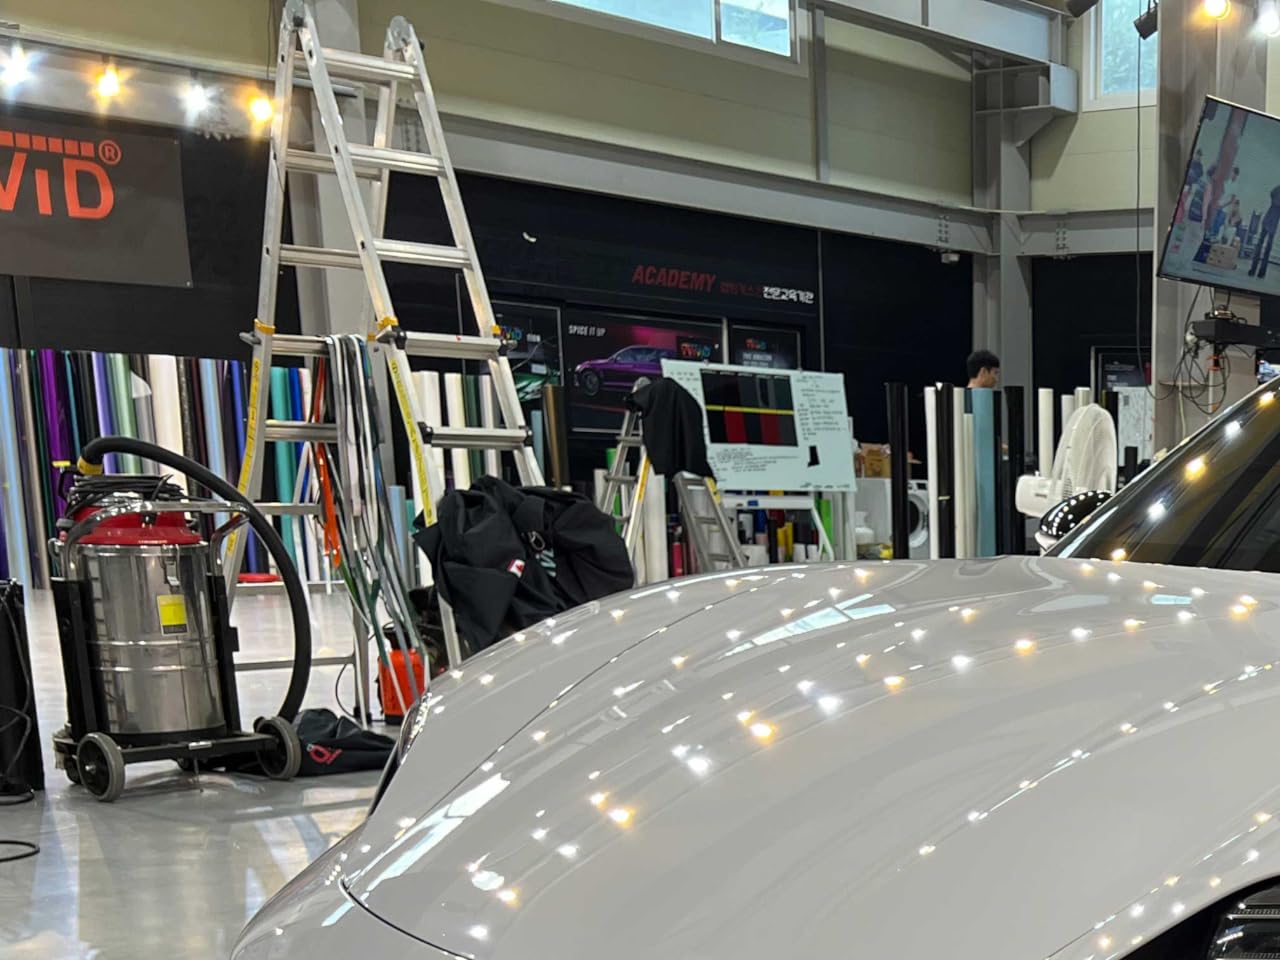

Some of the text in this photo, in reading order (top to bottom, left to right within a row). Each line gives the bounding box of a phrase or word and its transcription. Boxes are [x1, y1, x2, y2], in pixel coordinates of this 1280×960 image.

[632, 265, 716, 292] ACADEMY
[568, 325, 588, 336] SPICE
[596, 328, 606, 337] UP
